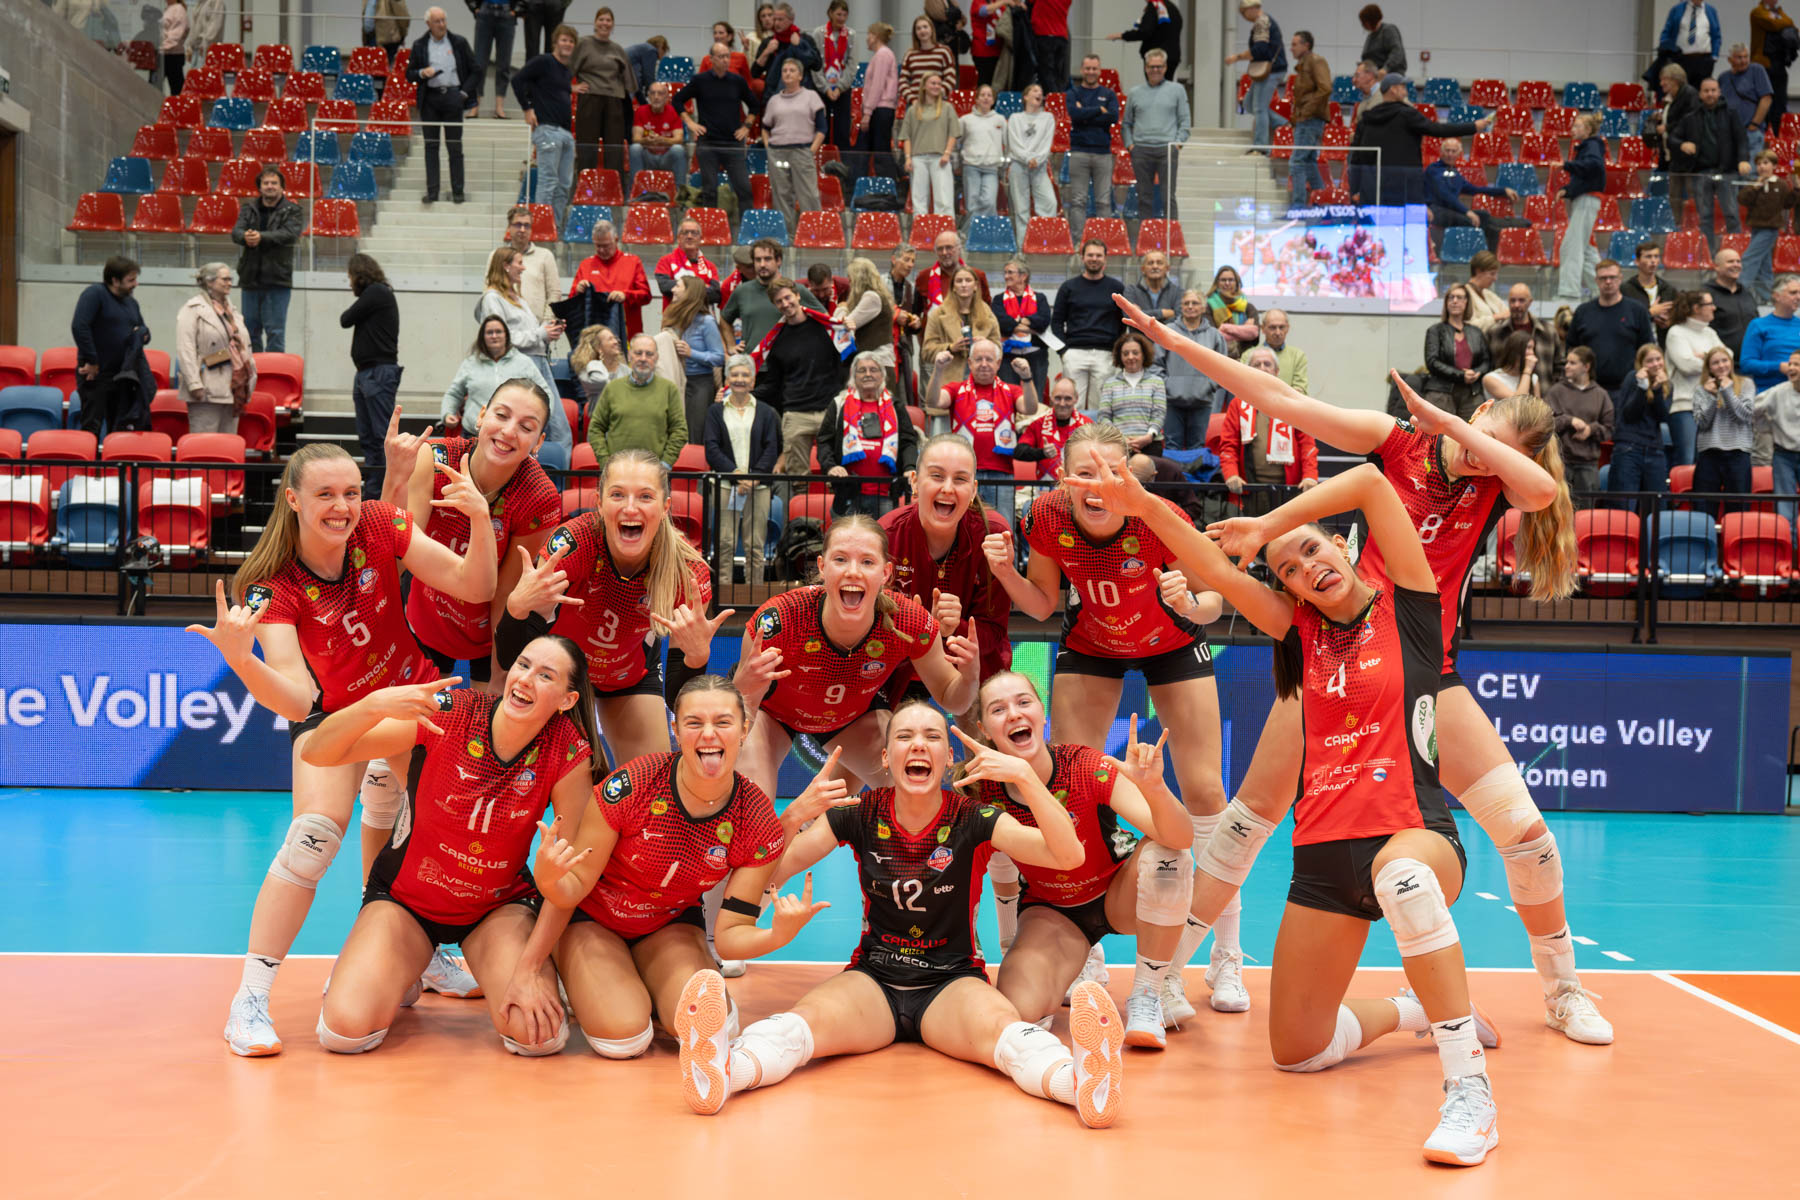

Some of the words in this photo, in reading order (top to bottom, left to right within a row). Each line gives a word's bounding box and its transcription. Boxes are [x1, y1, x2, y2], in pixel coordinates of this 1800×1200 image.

[562, 530, 574, 542] CEV
[1419, 514, 1443, 543] 8
[252, 586, 266, 594] CEV
[1086, 579, 1120, 608] 10
[342, 610, 371, 647] 5
[597, 609, 620, 642] 3
[1194, 642, 1211, 663] 10
[1359, 657, 1381, 670] lotto
[346, 642, 398, 692] CAROLUS
[1326, 661, 1346, 698] 4
[823, 684, 846, 704] 9
[1477, 673, 1541, 700] CEV
[61, 673, 257, 744] Volley
[1494, 718, 1607, 749] League
[1617, 718, 1713, 753] Volley
[621, 773, 630, 787] CEV
[467, 796, 496, 834] 11
[439, 842, 509, 869] CAROLUS
[458, 861, 484, 876] REIZEN
[442, 873, 483, 892] IVECO
[660, 861, 679, 887] 1
[891, 878, 927, 912] 12
[934, 884, 954, 895] lotto
[881, 933, 949, 949] CAROLUS
[891, 953, 929, 968] IVECO
